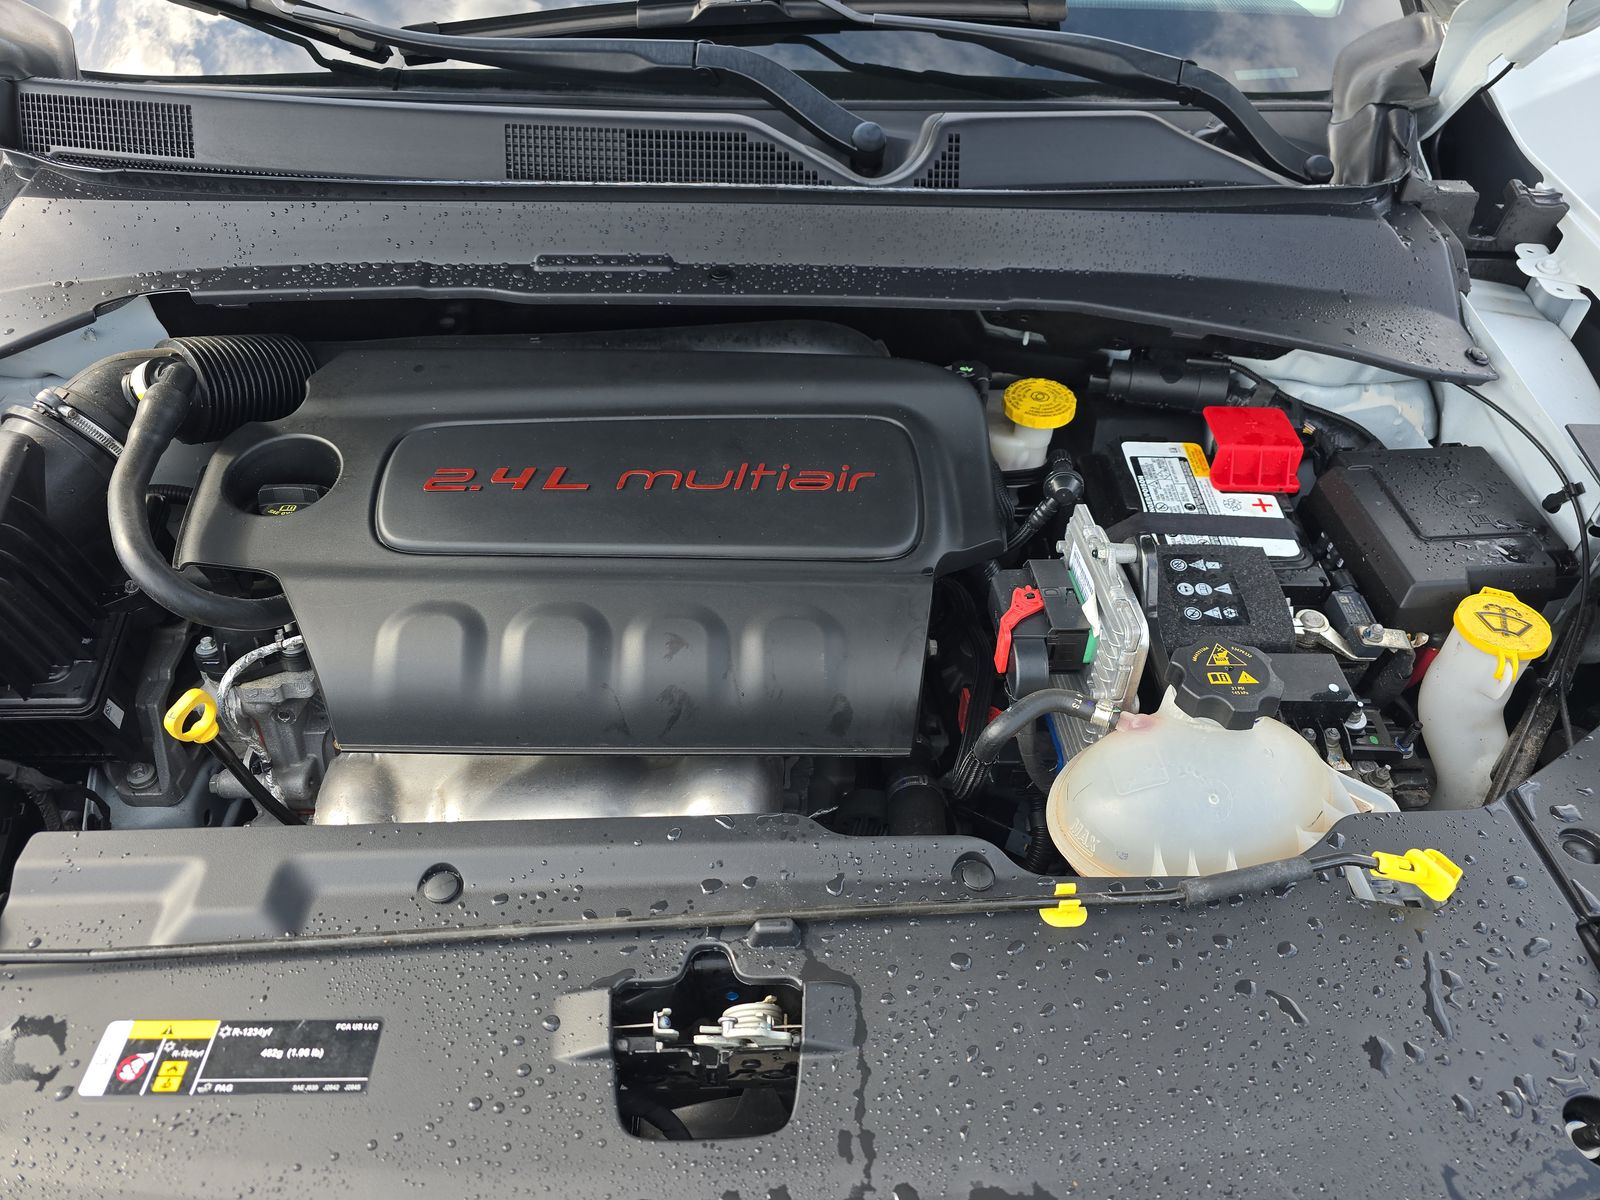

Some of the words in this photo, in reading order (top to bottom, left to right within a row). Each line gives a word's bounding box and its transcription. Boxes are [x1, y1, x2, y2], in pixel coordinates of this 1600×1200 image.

[423, 466, 591, 492] 2.4L
[616, 462, 876, 492] multiair
[335, 1022, 351, 1031] FCA
[352, 1022, 363, 1031] US
[363, 1022, 379, 1031] LLC
[231, 1026, 274, 1039] R-1234yf
[214, 1083, 234, 1093] PAG
